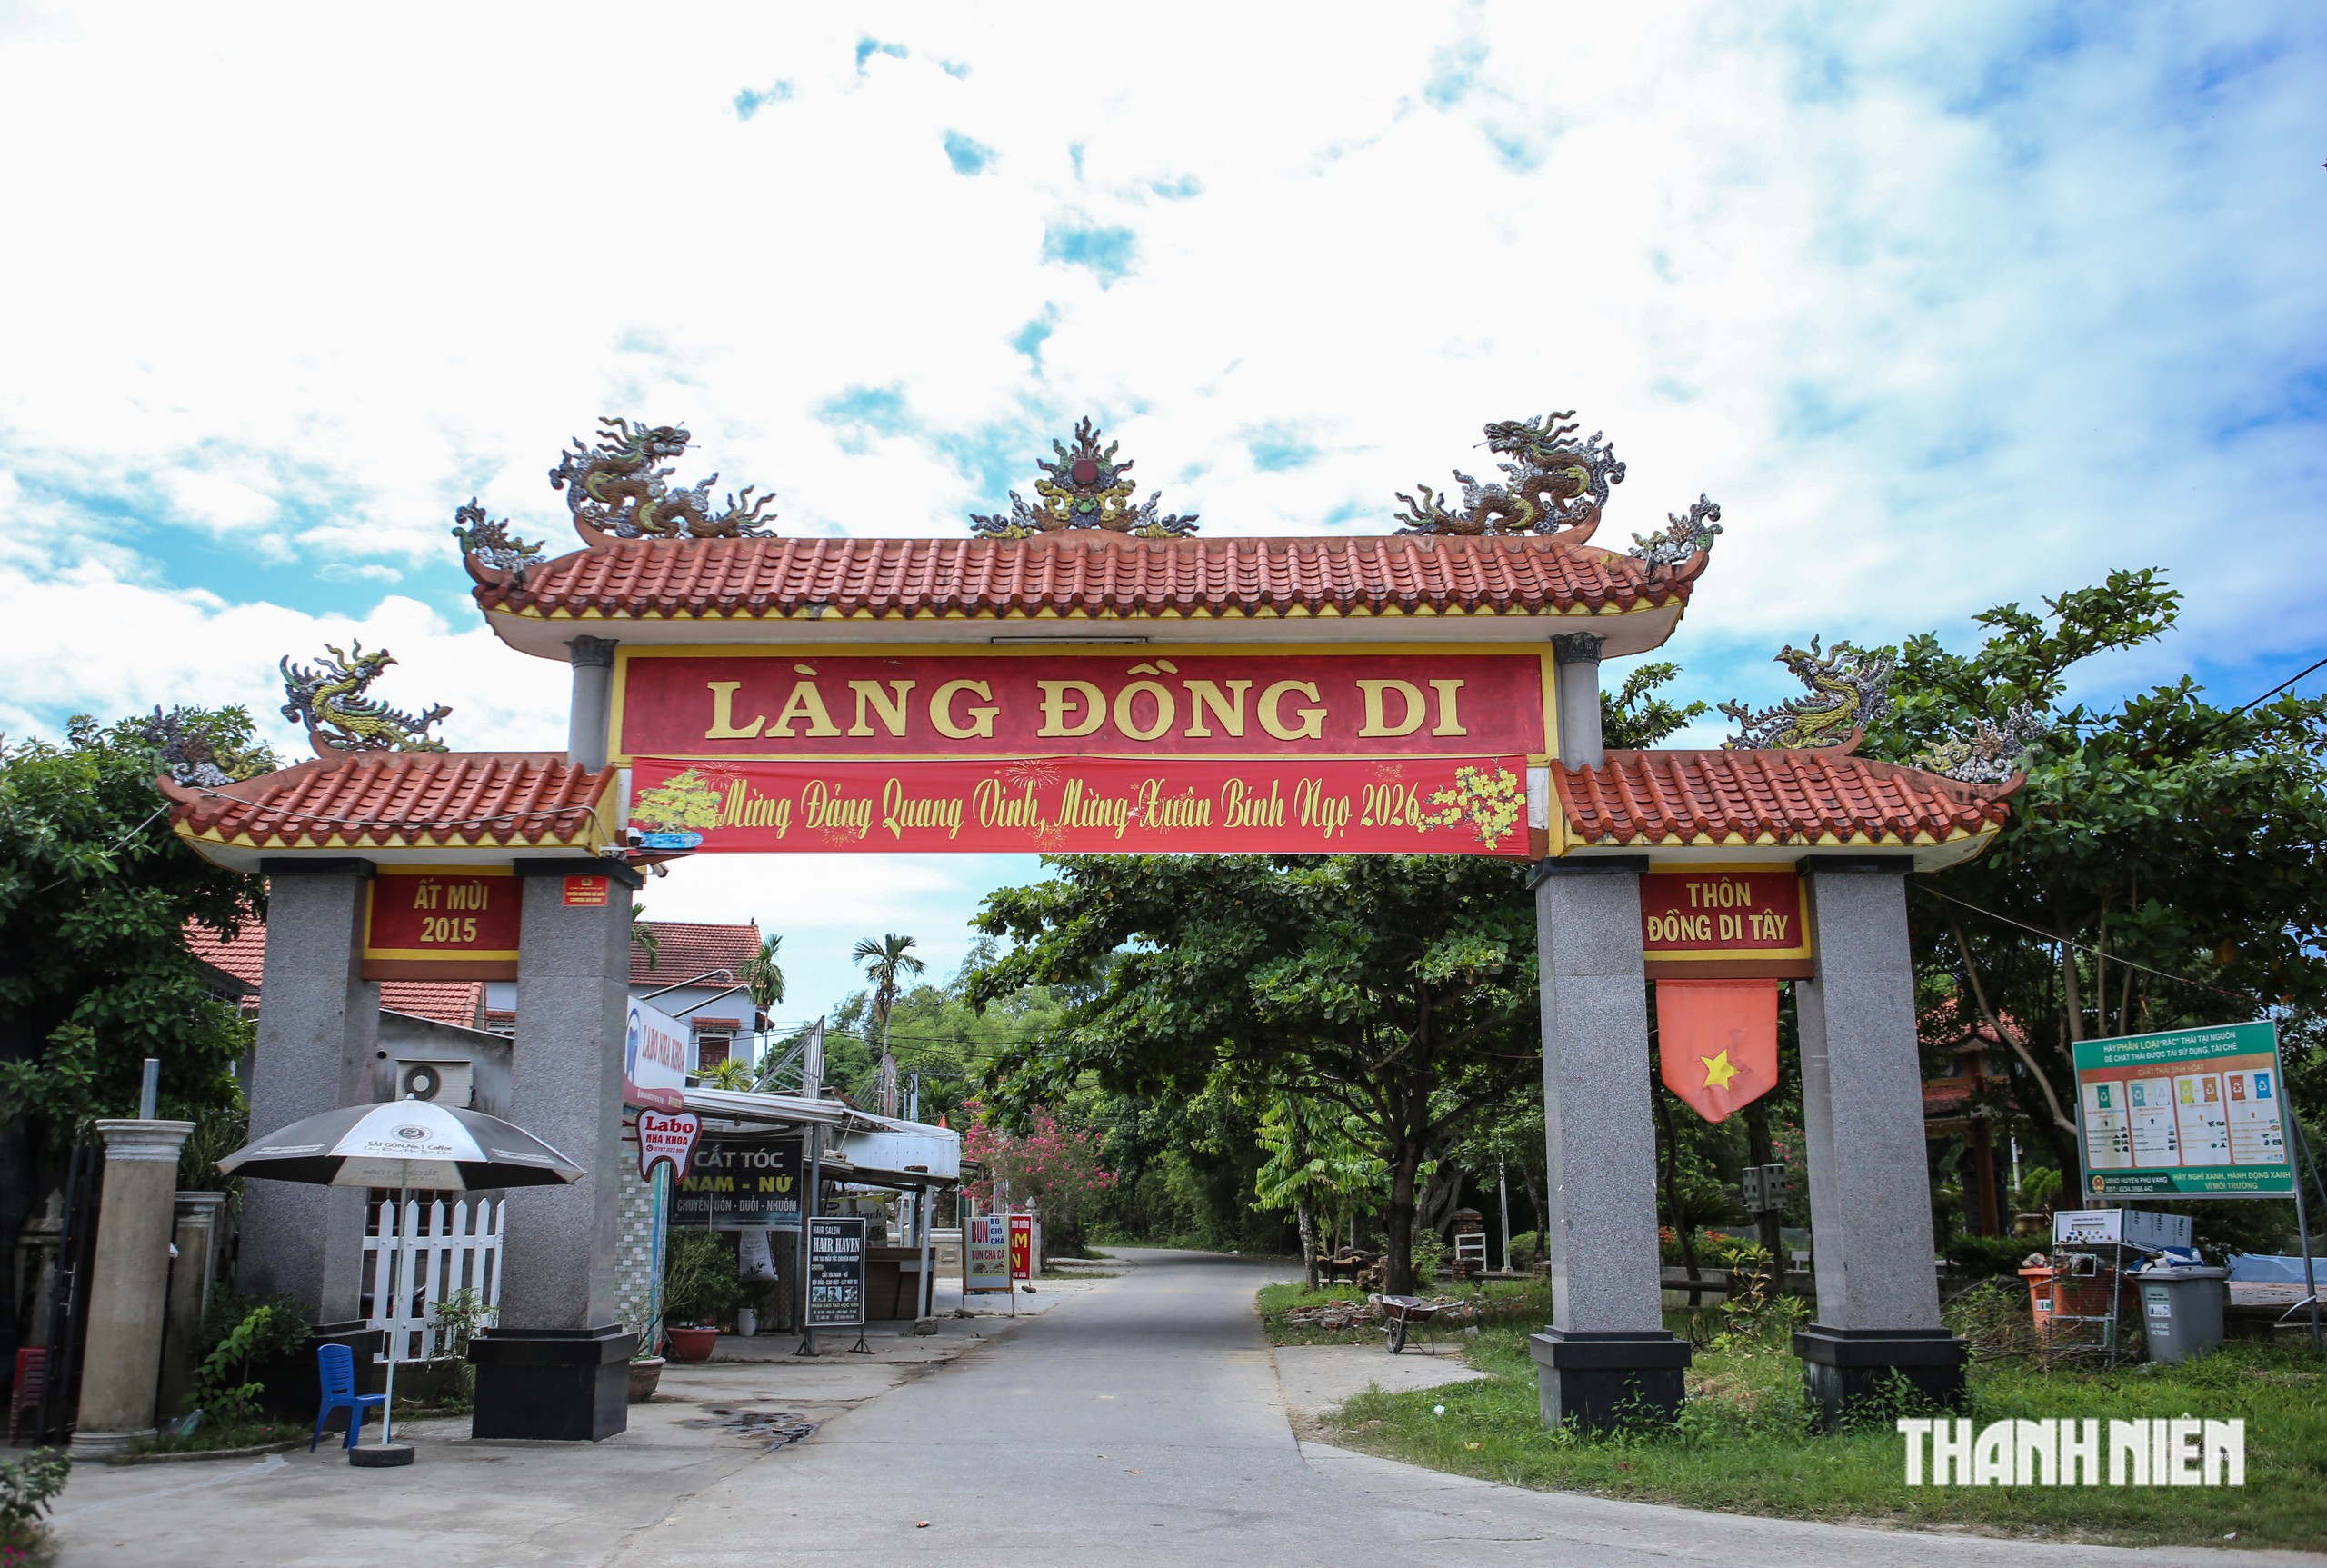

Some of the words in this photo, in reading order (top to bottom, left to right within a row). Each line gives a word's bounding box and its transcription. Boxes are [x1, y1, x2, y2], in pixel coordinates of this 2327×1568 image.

[704, 663, 1001, 740] LÀNG
[1035, 658, 1328, 742] ĐỒNG
[1354, 678, 1468, 738] DI
[716, 778, 793, 840] Mừng
[800, 779, 874, 840] Đảng
[882, 777, 964, 841] Quang
[1053, 777, 1131, 840] Mừng
[1138, 777, 1213, 829] Xuân
[1220, 777, 1286, 828] Bính
[1293, 777, 1353, 839] Ngọ
[1359, 781, 1421, 827] 2026
[414, 877, 443, 910] ẤT
[446, 880, 489, 911] MÙI
[1685, 876, 1752, 908] THÔN
[419, 916, 478, 944] 2015
[1646, 908, 1712, 943] ĐỒNG
[1718, 914, 1743, 941] DI
[1748, 908, 1789, 941] TÂY
[644, 1116, 694, 1134] Labo
[645, 1134, 663, 1144] NHA
[665, 1135, 688, 1145] KHOA
[694, 1144, 736, 1168] CẮT
[740, 1147, 784, 1168] TÓC
[682, 1175, 734, 1192] NAM
[677, 1197, 709, 1212] CHUYÊN
[766, 1197, 797, 1214] NHUỘM
[813, 1225, 824, 1235] HAIR
[824, 1225, 841, 1235] SALON
[812, 1237, 834, 1253] HAIR
[835, 1237, 861, 1253] HAVEN
